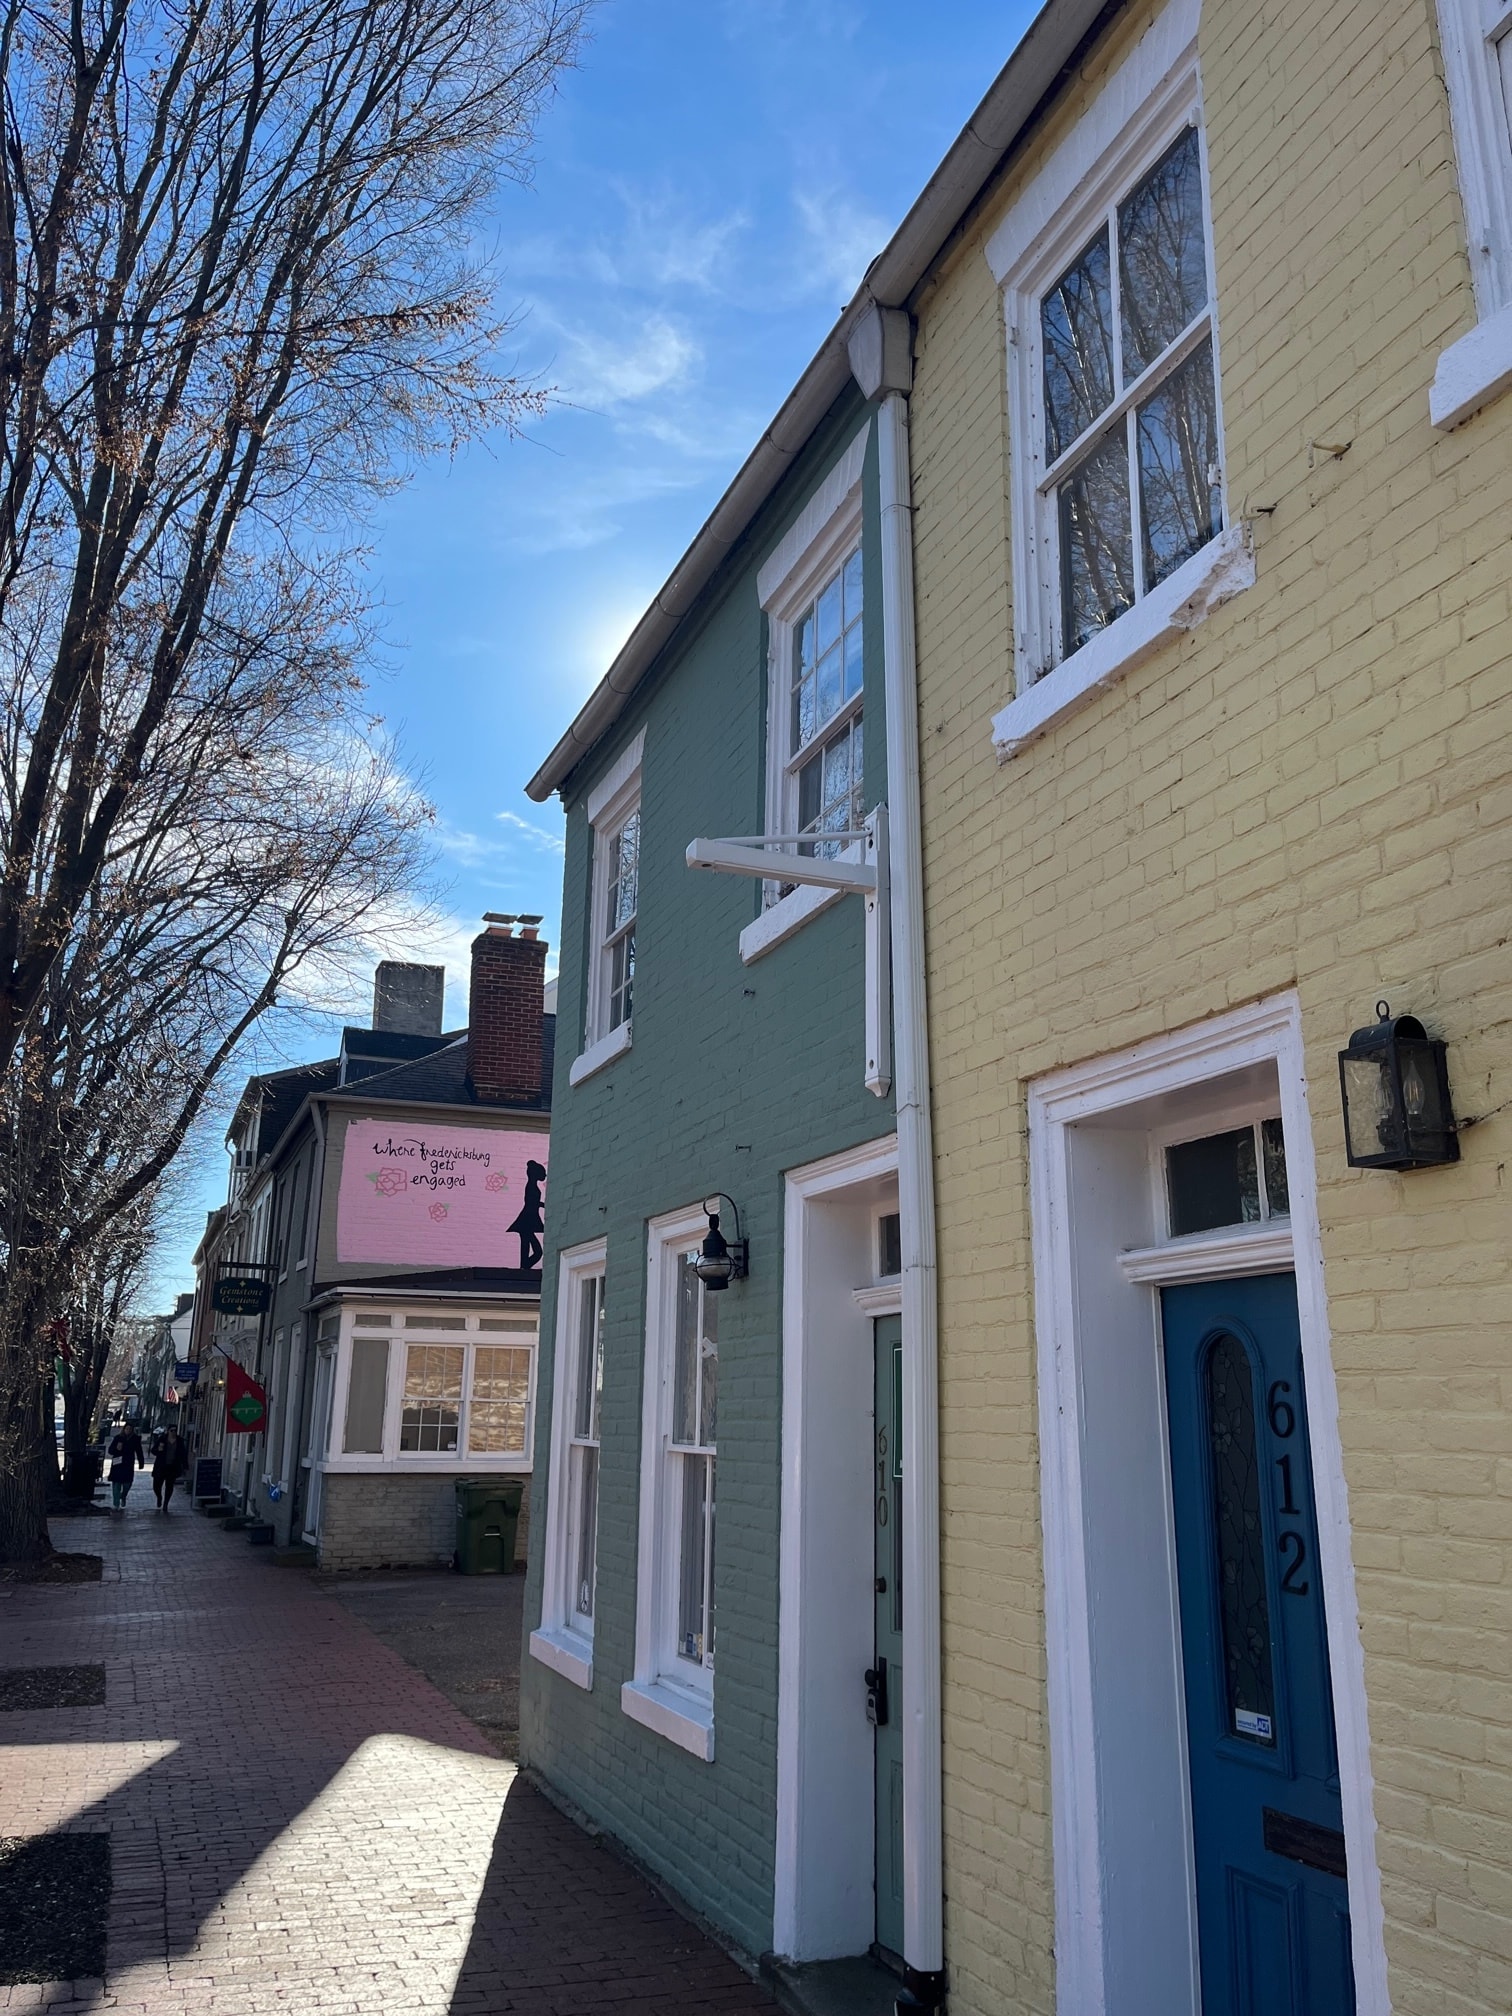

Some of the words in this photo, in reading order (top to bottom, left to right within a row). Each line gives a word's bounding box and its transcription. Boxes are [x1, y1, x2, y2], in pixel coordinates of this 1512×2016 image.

[373, 1138, 415, 1157] where
[430, 1159, 456, 1174] gets
[410, 1175, 465, 1190] engaged
[219, 1286, 264, 1296] Gemstone
[878, 1424, 888, 1527] 610
[1267, 1380, 1309, 1596] 612
